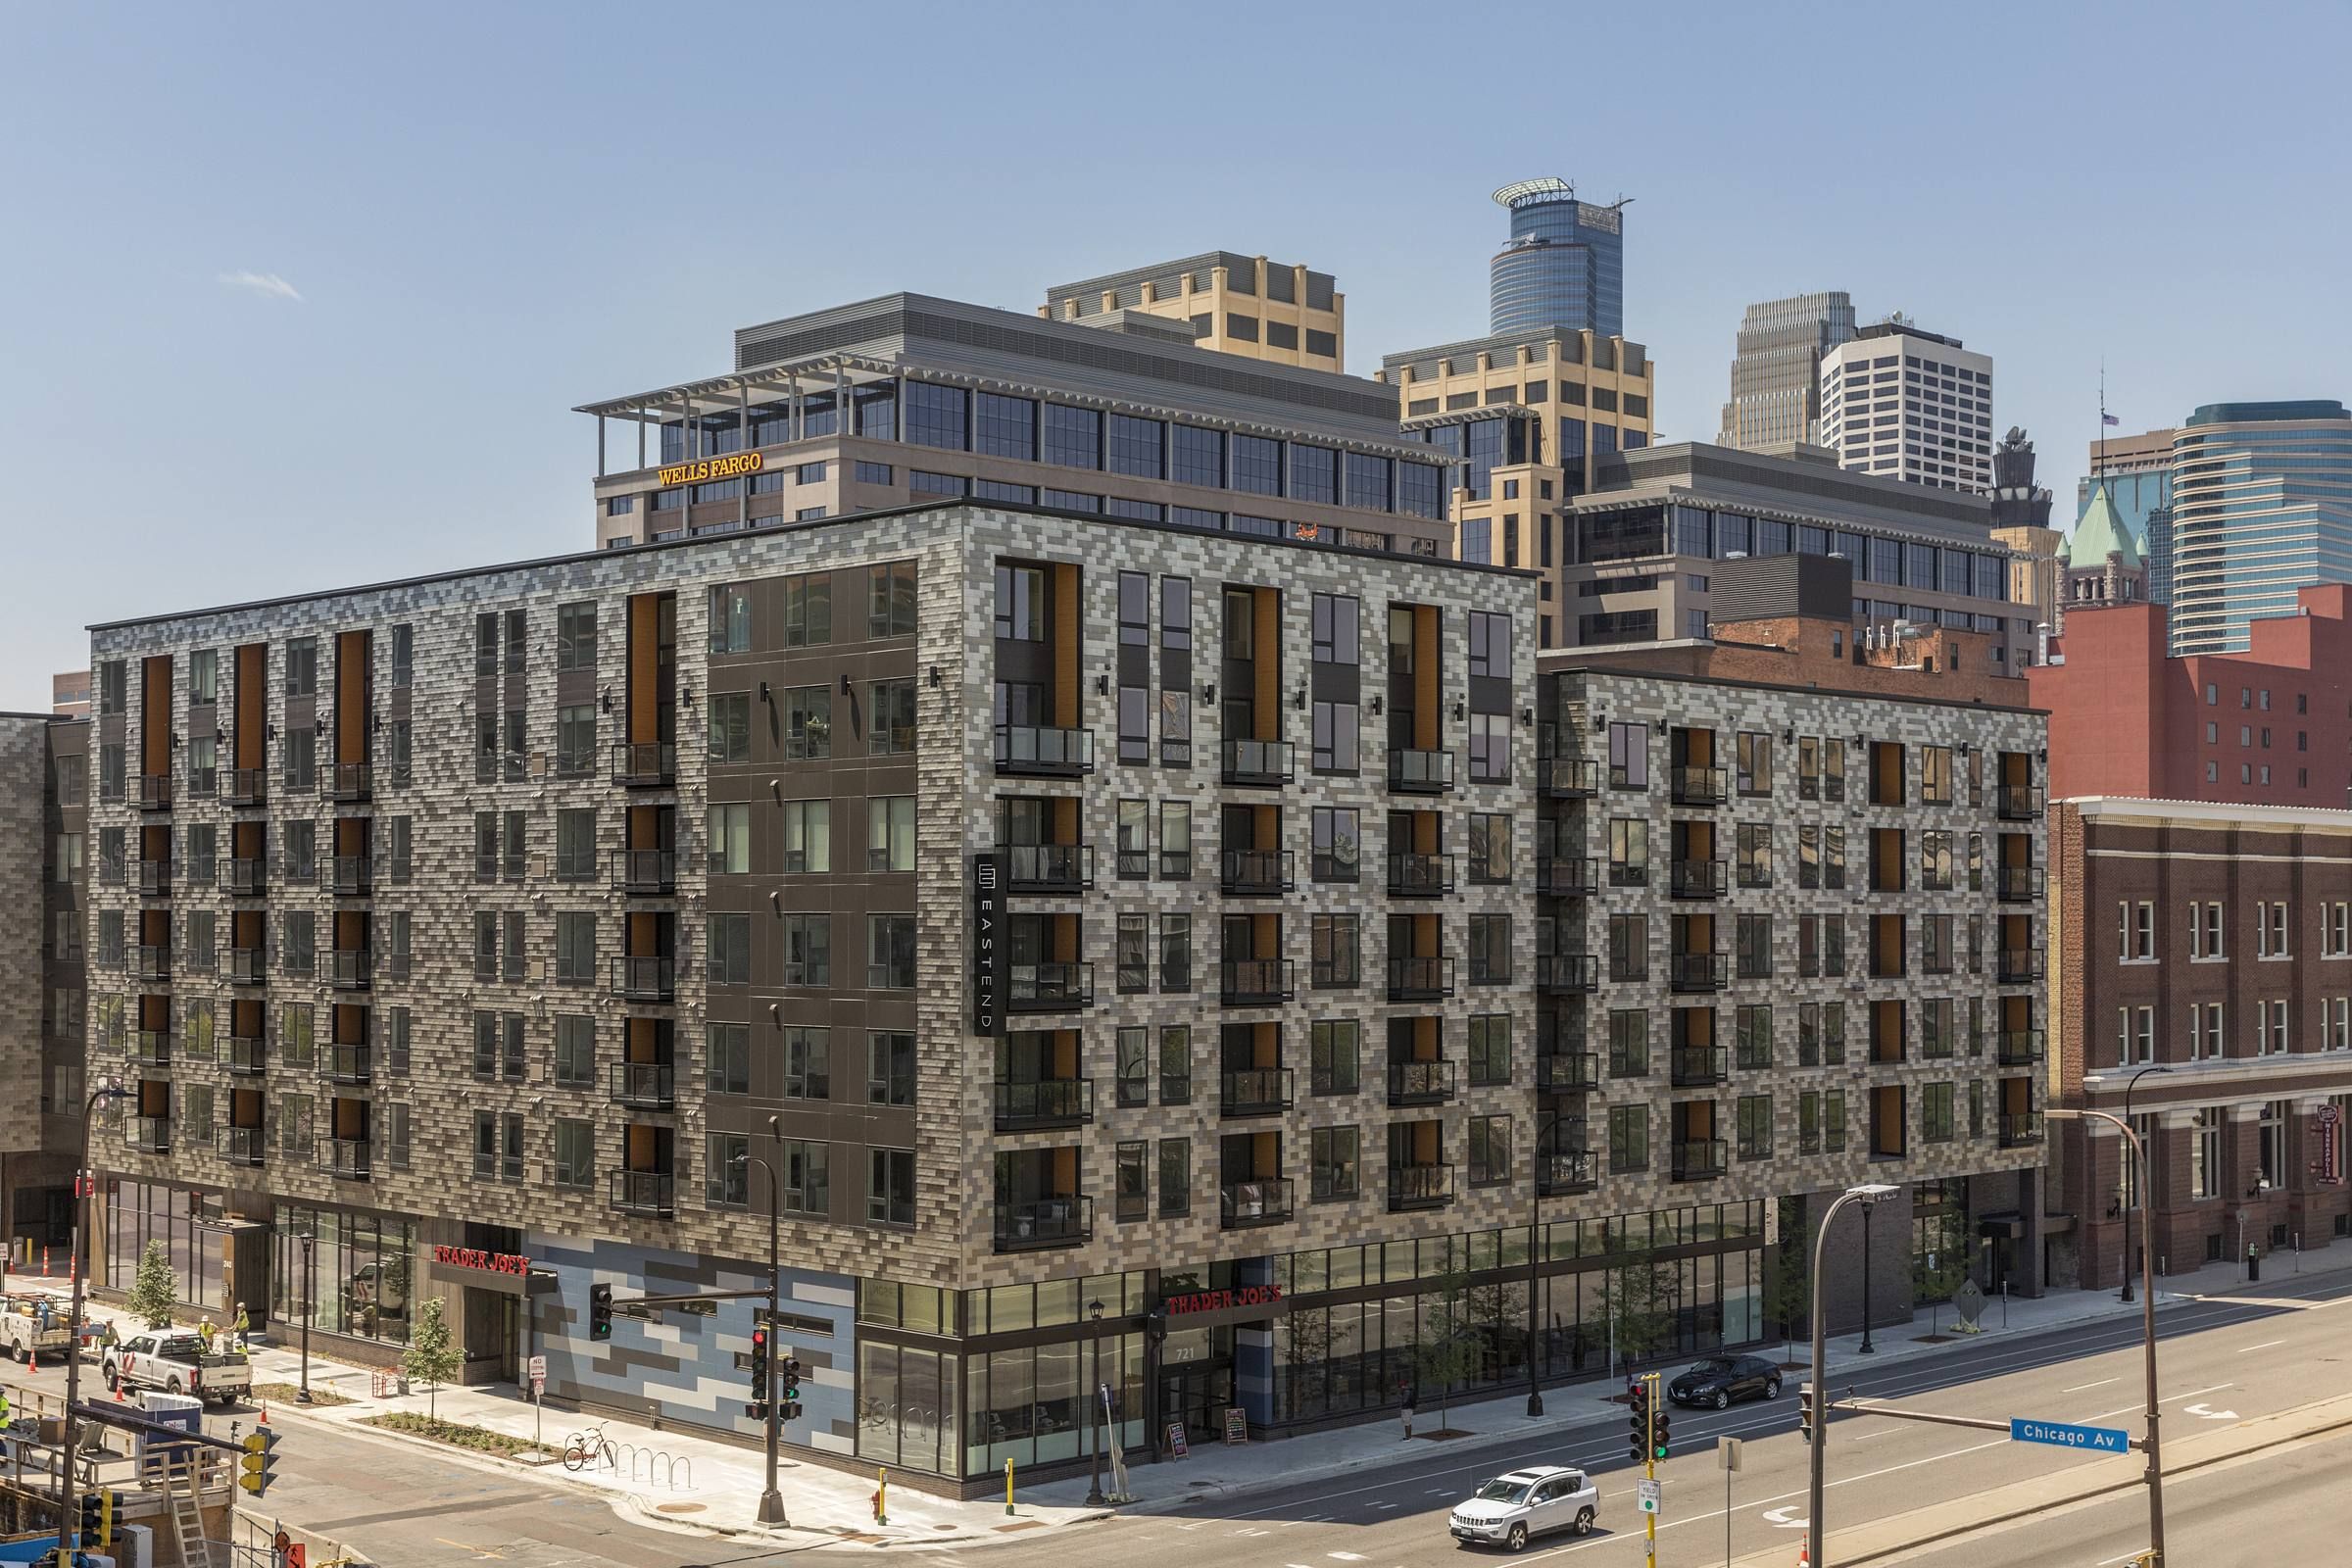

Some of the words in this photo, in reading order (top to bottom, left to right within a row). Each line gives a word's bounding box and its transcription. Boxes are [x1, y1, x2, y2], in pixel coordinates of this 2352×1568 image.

[659, 462, 709, 486] WELLS
[710, 453, 761, 477] FARGO
[434, 1245, 488, 1270] TRADER
[489, 1252, 530, 1277] JOE'S
[1168, 1290, 1233, 1316] TRADER
[1238, 1285, 1282, 1306] JOE'S
[1176, 1348, 1194, 1360] 721
[2024, 1425, 2084, 1446] Chicago
[2093, 1433, 2115, 1446] Av
